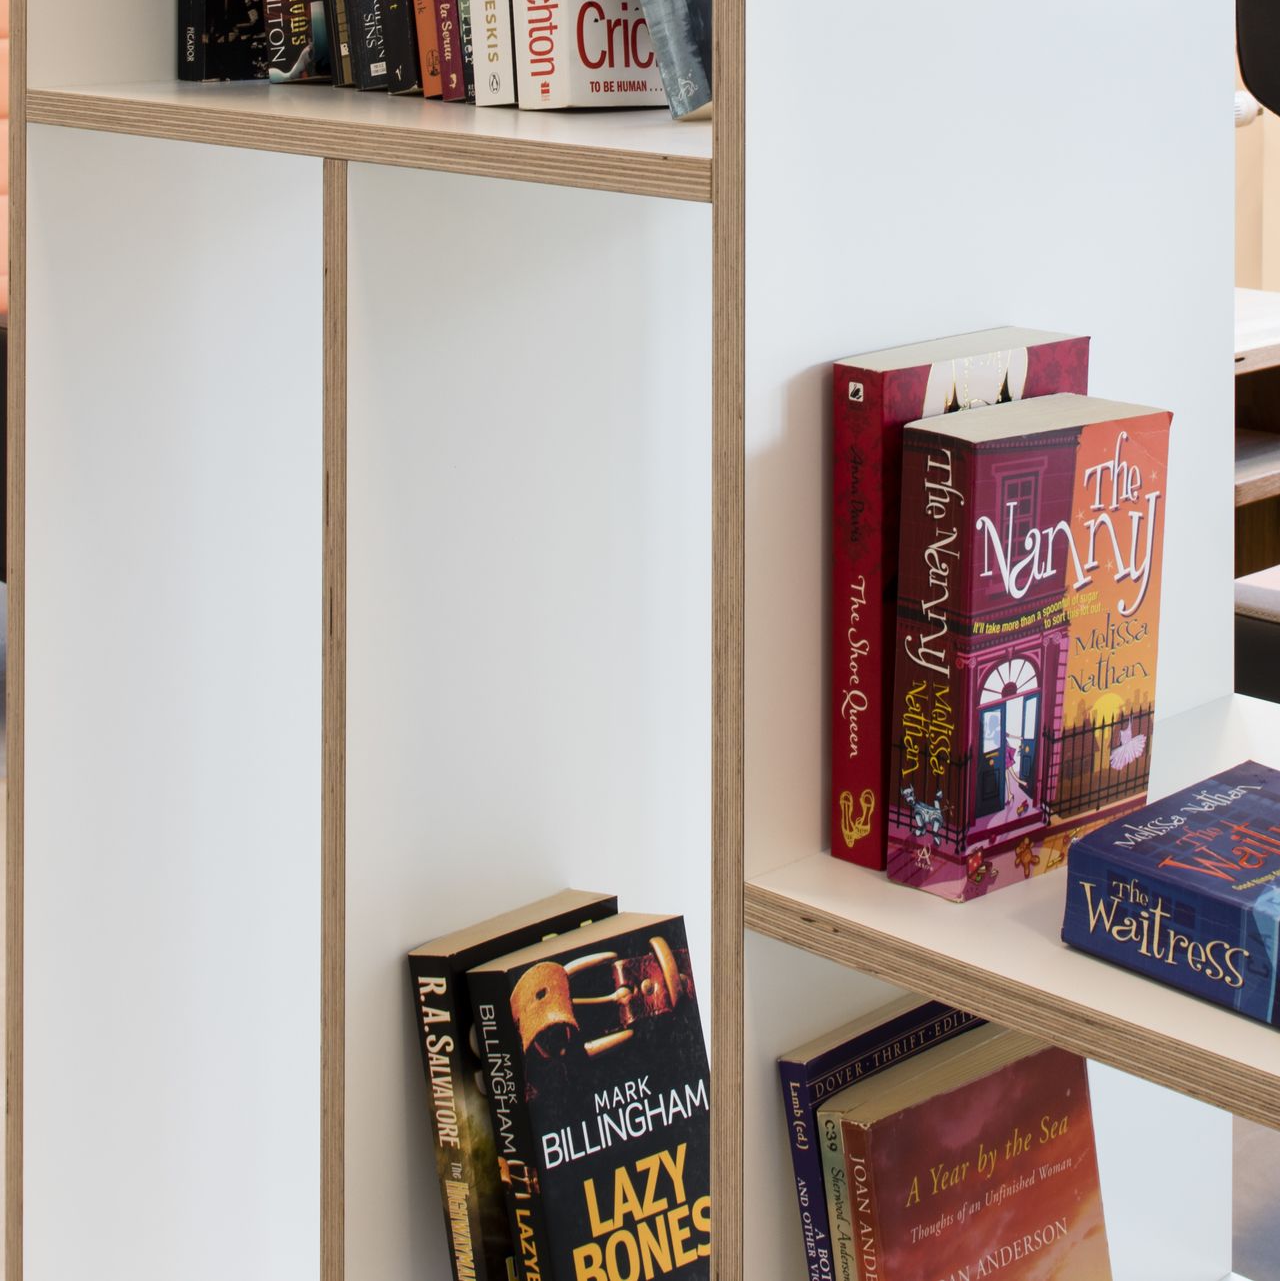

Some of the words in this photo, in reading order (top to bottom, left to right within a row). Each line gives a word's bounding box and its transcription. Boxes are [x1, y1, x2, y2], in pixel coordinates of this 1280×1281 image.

[363, 14, 374, 48] SINS
[439, 4, 448, 18] la
[186, 26, 195, 62] PICADOR
[441, 21, 453, 61] Serna
[925, 448, 964, 520] The
[1083, 431, 1141, 512] The
[976, 491, 1161, 616] Nanny
[904, 527, 961, 679] Nanny
[973, 621, 985, 634] It'll
[985, 622, 1000, 634] take
[1002, 620, 1019, 632] more
[1020, 614, 1036, 631] than
[1075, 615, 1149, 656] Melissa
[1068, 651, 1151, 693] Nathan
[1114, 814, 1186, 849] Melissa
[1181, 784, 1264, 814] Nathan
[1080, 881, 1250, 988] Waitress
[479, 1005, 516, 1154] BILLINGHAM
[502, 1054, 517, 1104] MARK
[814, 1064, 863, 1099] DOVER
[872, 1031, 925, 1068] THRIFT
[933, 1011, 978, 1038] EDIT
[595, 1076, 652, 1113] MARK
[789, 1081, 803, 1118] Lamb
[541, 1079, 710, 1169] BILLINGHAM
[793, 1120, 809, 1150] (ed.)
[905, 1177, 921, 1208] A
[929, 1161, 970, 1194] Year
[978, 1144, 998, 1178] by
[1005, 1128, 1032, 1161] the
[1040, 1114, 1069, 1144] Sea
[584, 1143, 687, 1238] LAZY
[797, 1177, 811, 1207] AND
[516, 1209, 540, 1272] LAZY
[802, 1211, 818, 1259] OTHER
[976, 1217, 1069, 1281] ANDERSON
